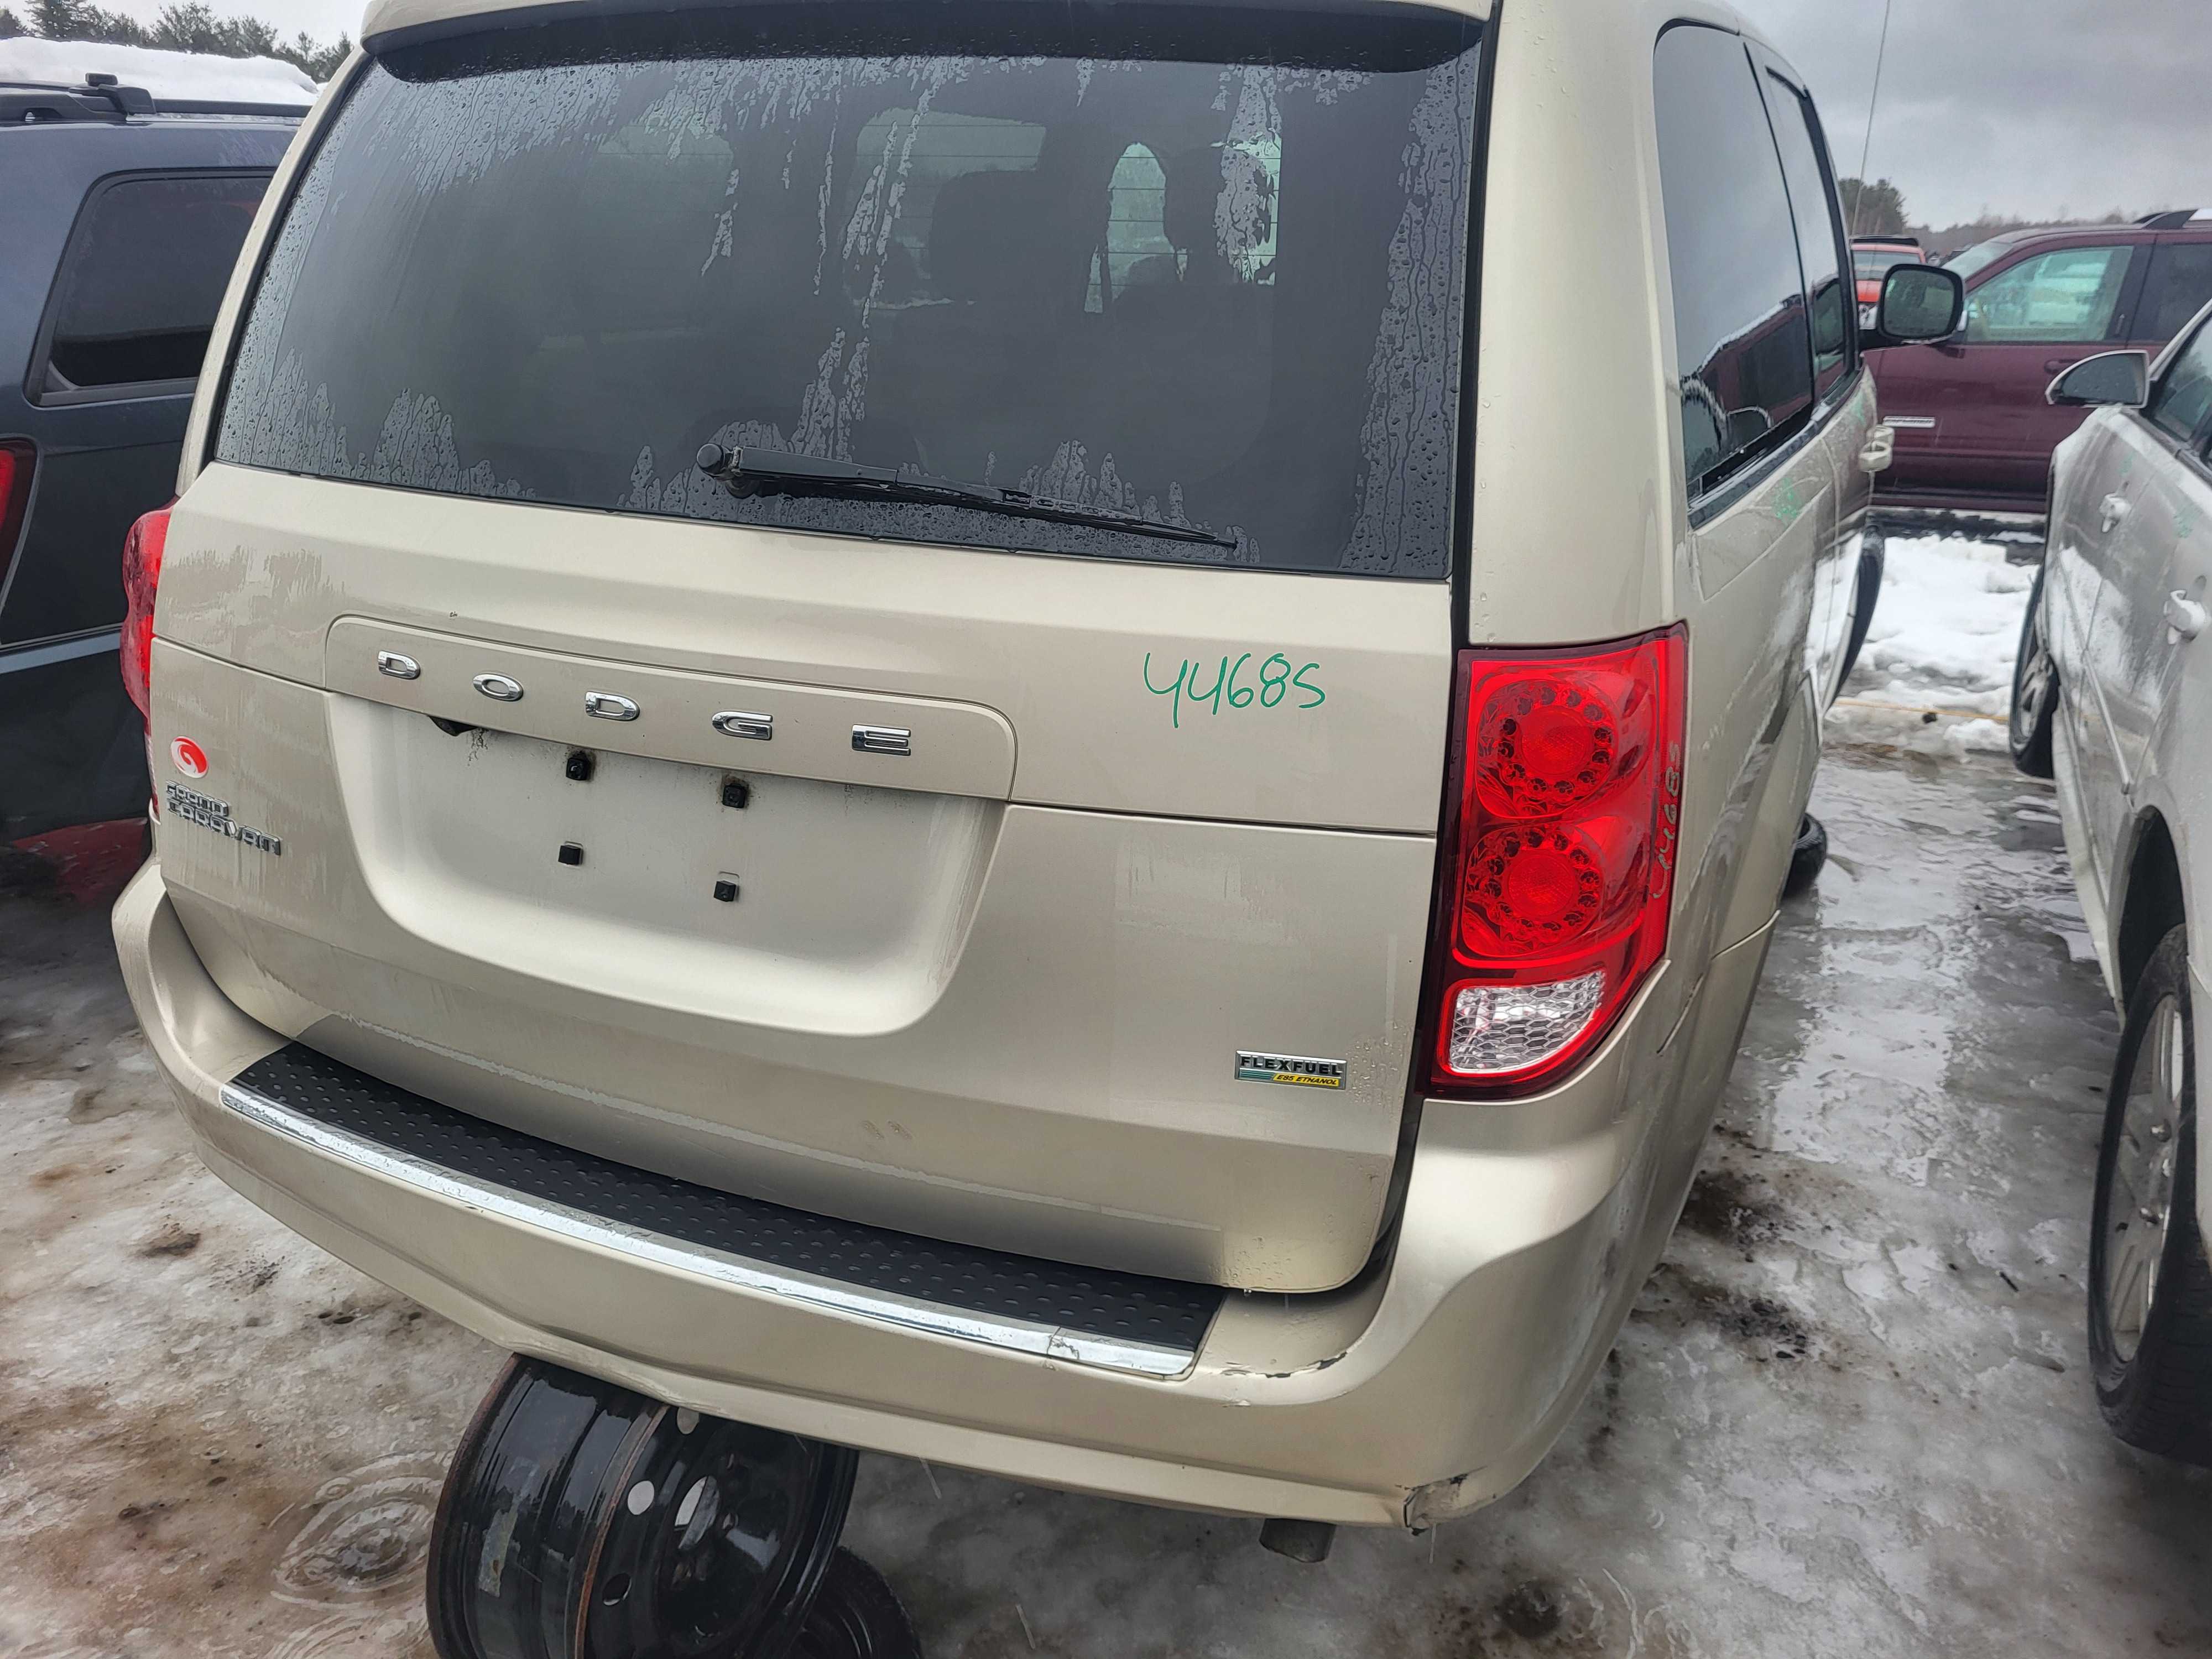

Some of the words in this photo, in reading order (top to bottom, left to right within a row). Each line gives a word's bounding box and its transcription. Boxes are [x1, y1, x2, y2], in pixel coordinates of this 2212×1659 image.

[377, 649, 912, 757] DODGE
[166, 780, 229, 817] GRAND
[166, 797, 282, 857] CARAVAN
[1240, 1054, 1343, 1076] FLEXFUEL
[1297, 1076, 1337, 1085] ETHANOL
